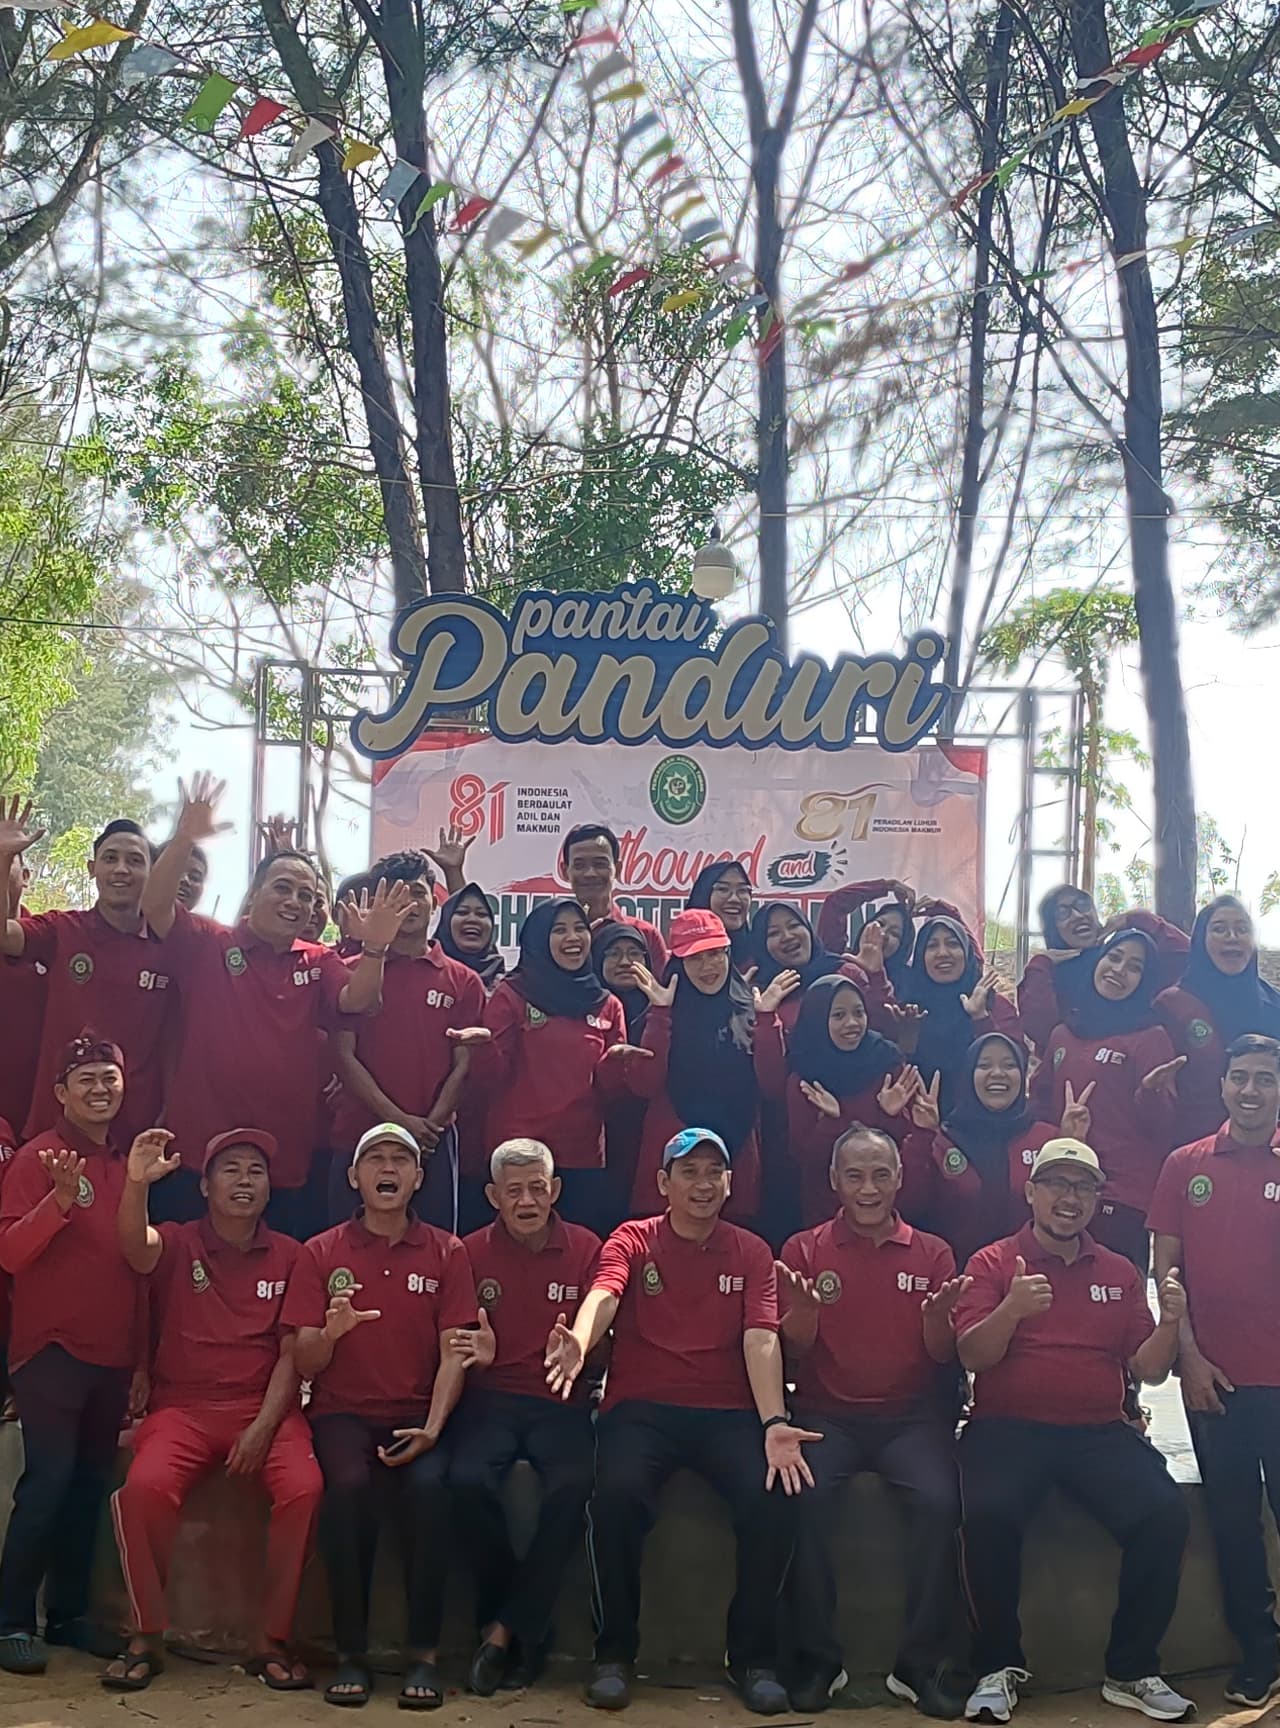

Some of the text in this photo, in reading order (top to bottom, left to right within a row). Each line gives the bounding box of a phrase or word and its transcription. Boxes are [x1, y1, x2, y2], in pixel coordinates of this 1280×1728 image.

[511, 587, 709, 655] pantai
[357, 601, 943, 752] Panduri
[517, 787, 569, 797] INDONESIA
[449, 773, 512, 846] 81
[517, 799, 573, 810] BERDAULAT
[517, 811, 560, 821] ADIL DAN
[794, 789, 878, 842] 81
[516, 823, 560, 833] MAKMUR
[557, 826, 766, 888] tboud
[779, 851, 815, 877] and
[426, 989, 444, 1008] 81
[257, 1280, 275, 1300] 81
[407, 1273, 426, 1294] 81
[897, 1272, 914, 1292] 81
[547, 1282, 565, 1303] 81
[1090, 1284, 1108, 1303] 81
